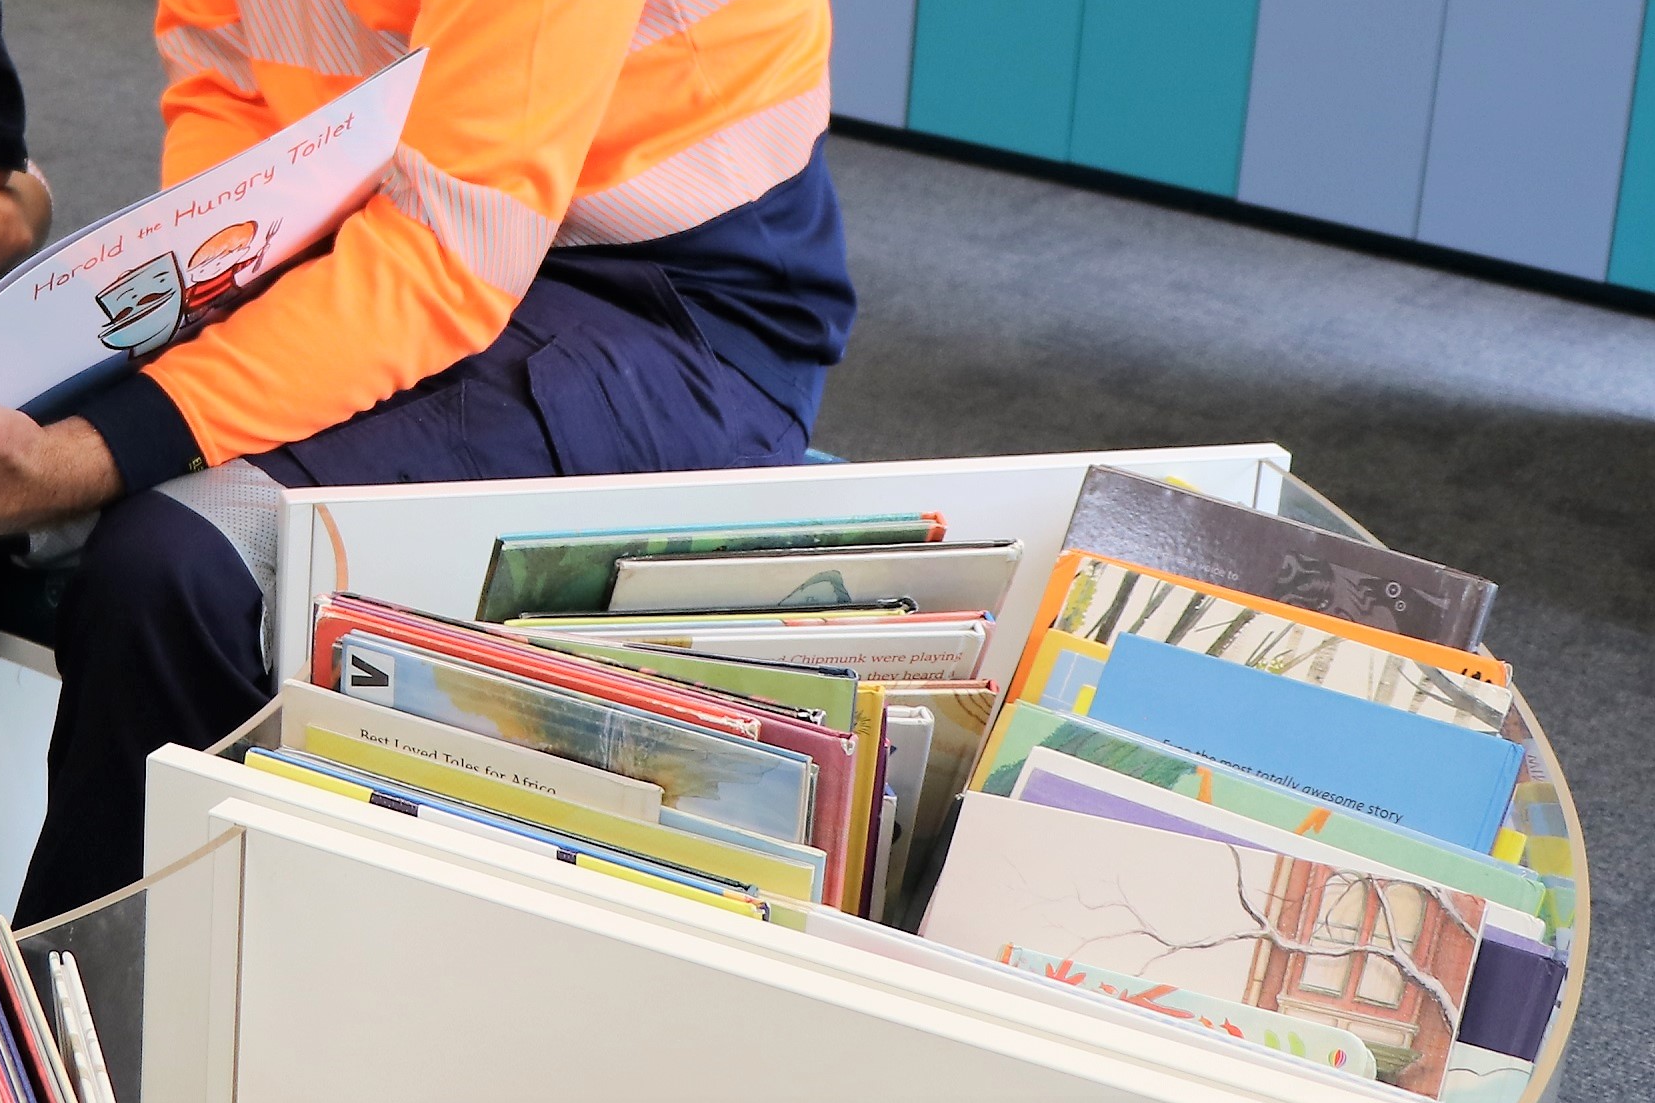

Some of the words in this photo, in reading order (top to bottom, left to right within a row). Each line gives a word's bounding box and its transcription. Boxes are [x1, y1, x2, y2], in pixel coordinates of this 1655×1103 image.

[34, 235, 124, 300] Harold
[138, 221, 163, 241] the
[173, 164, 276, 227] Hungry
[288, 111, 356, 167] Toilet
[791, 653, 867, 664] Chipmunk
[871, 655, 906, 663] were
[910, 652, 963, 664] playing
[902, 669, 944, 681] heard
[1302, 783, 1366, 812] awesome
[1368, 804, 1405, 825] story
